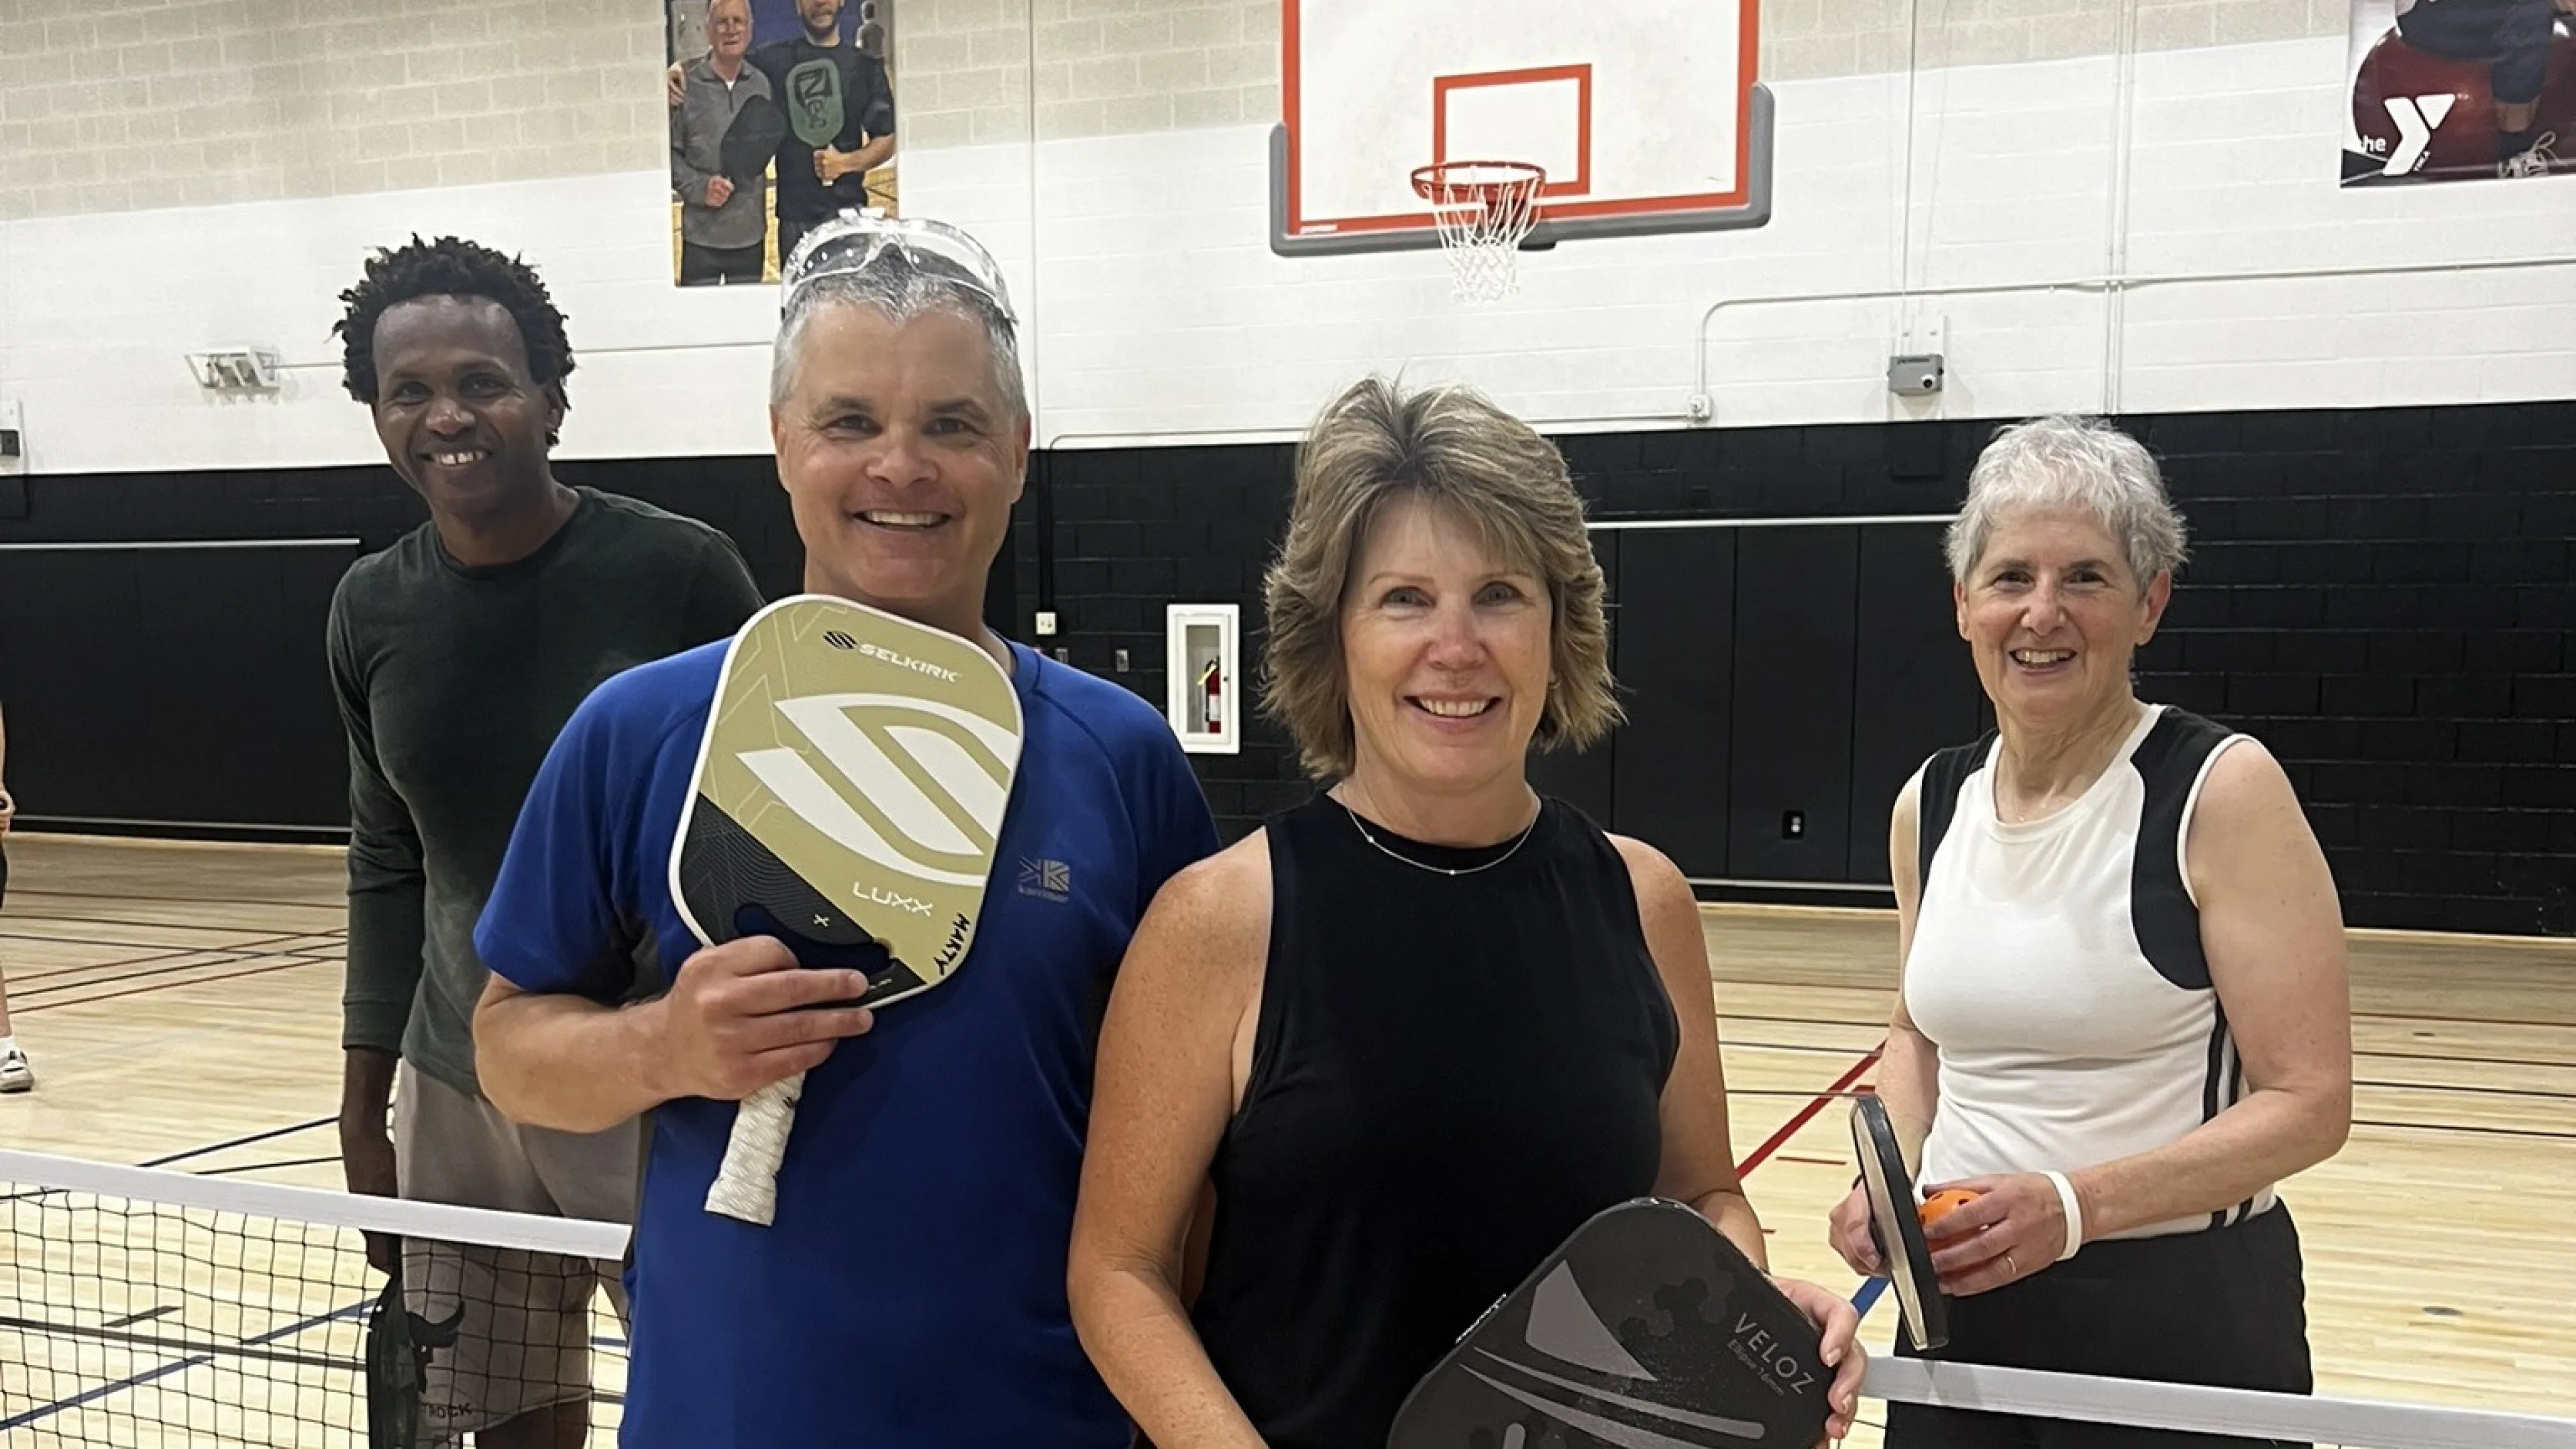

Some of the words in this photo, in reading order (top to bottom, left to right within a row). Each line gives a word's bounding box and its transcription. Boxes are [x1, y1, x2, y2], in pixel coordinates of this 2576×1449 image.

[2358, 134, 2386, 153] he
[2382, 93, 2456, 176] Y
[859, 643, 959, 684] SELKIRK
[853, 881, 934, 918] LUXX
[932, 912, 971, 975] MARTY
[1735, 1312, 1815, 1394] VELOZ
